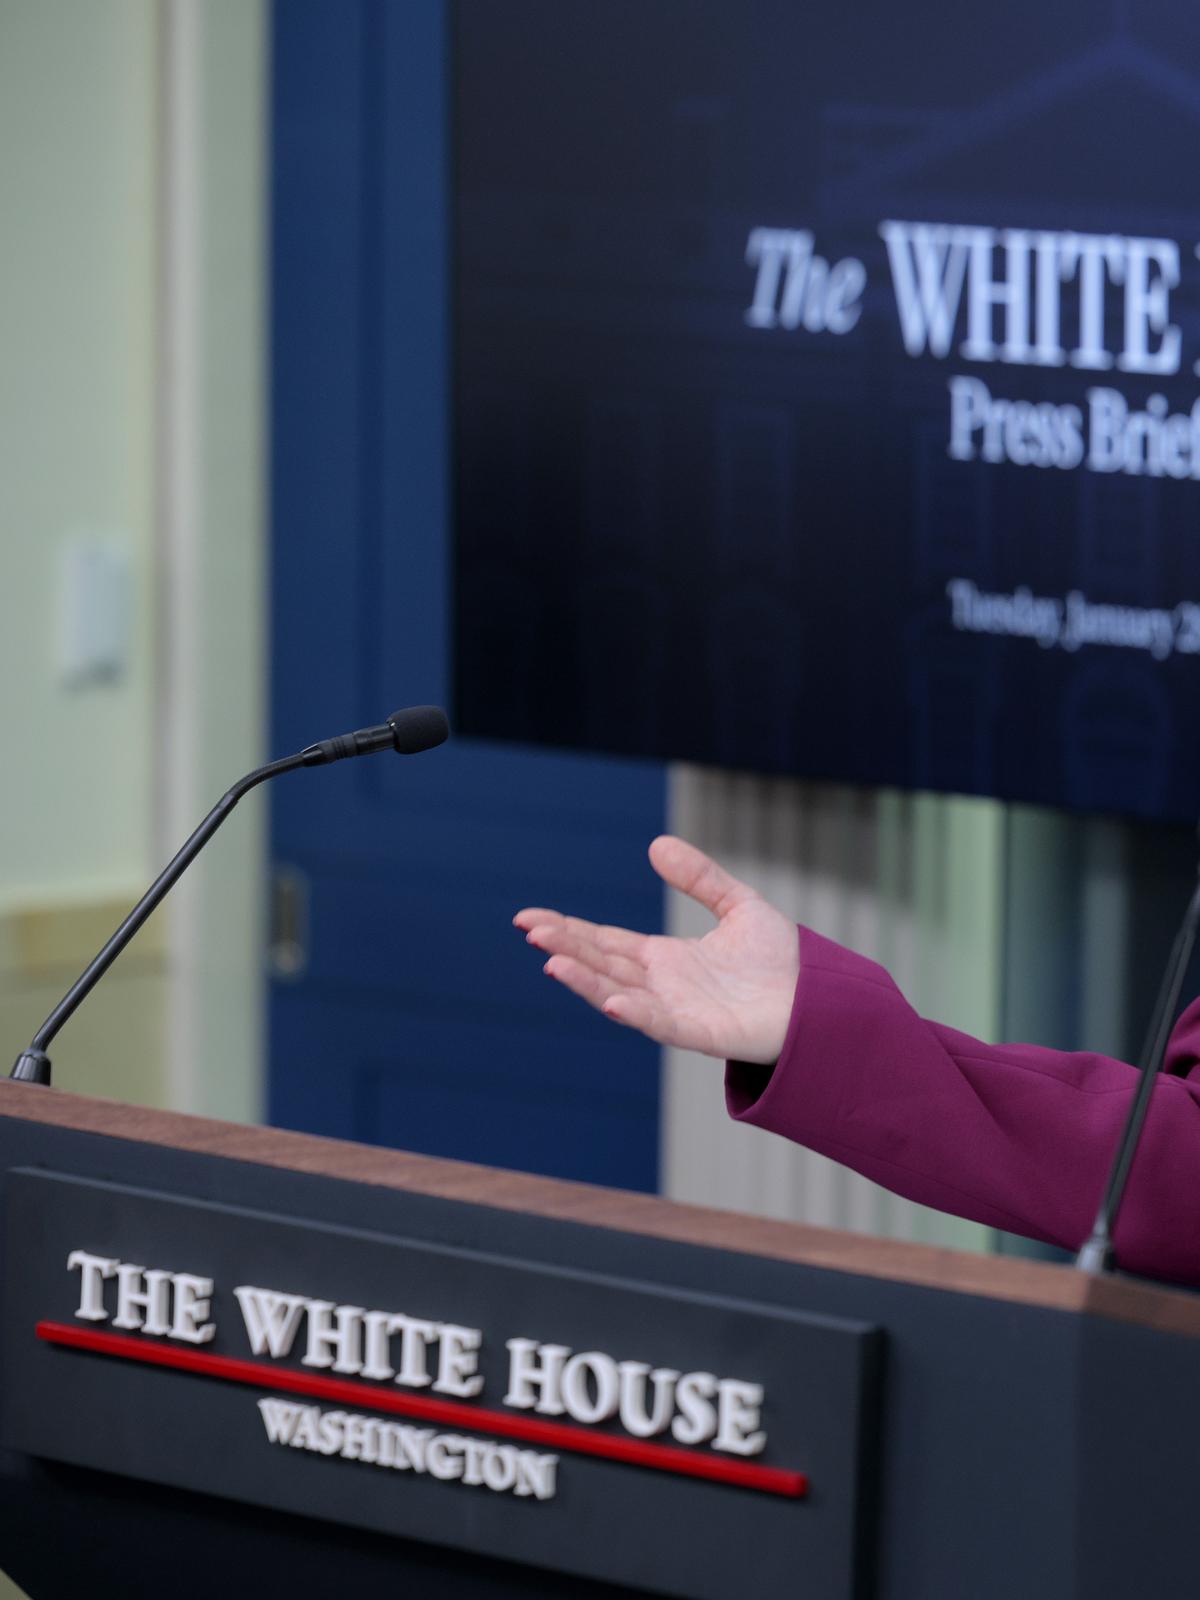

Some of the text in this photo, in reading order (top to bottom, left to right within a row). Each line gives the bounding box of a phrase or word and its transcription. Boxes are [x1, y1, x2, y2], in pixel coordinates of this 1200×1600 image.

[746, 227, 866, 335] The
[880, 220, 1181, 376] WHITE
[949, 375, 1083, 470] Press
[67, 1250, 766, 1455] THE WHITE HOUSE
[258, 1398, 558, 1499] WASHINGTON
